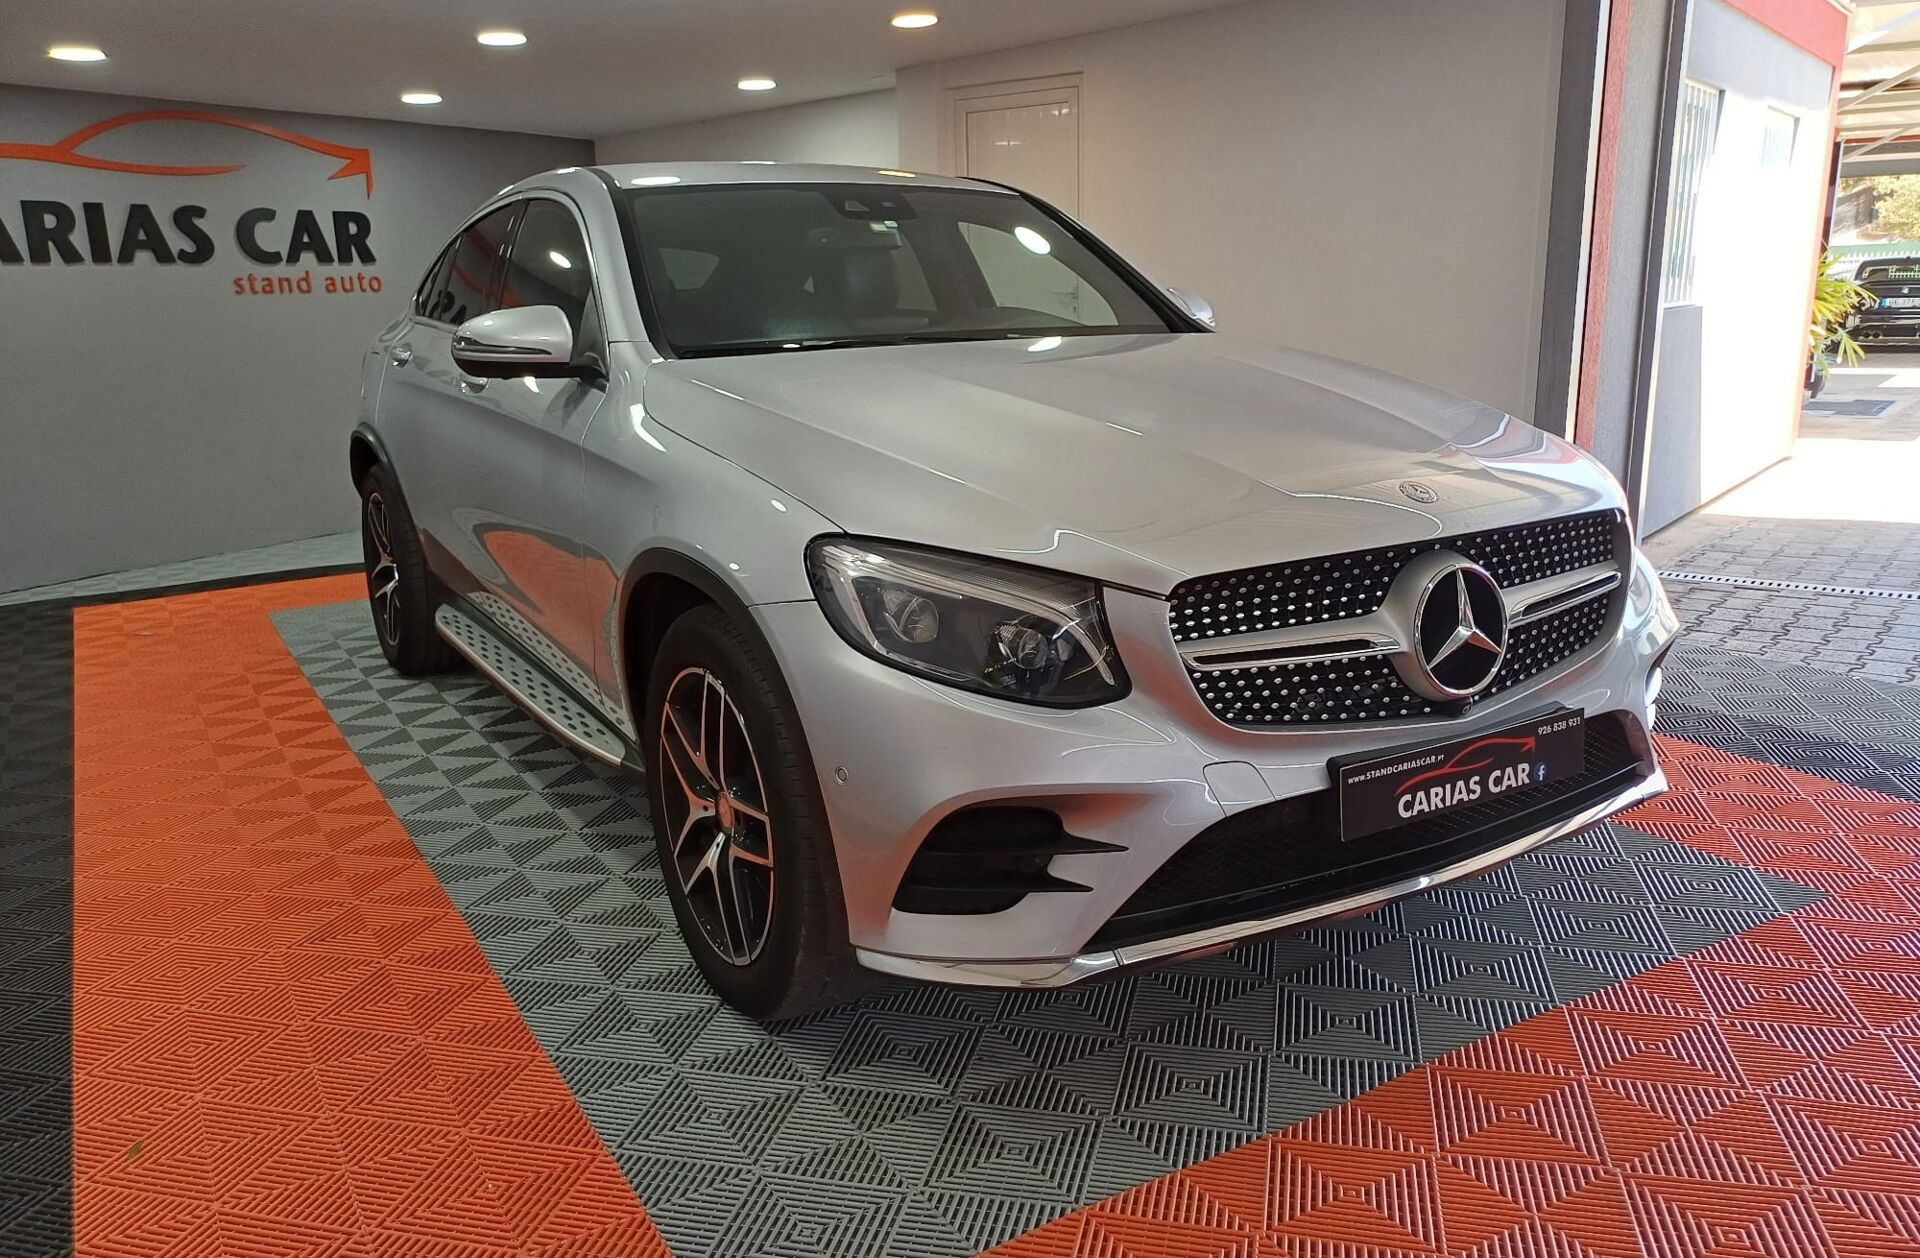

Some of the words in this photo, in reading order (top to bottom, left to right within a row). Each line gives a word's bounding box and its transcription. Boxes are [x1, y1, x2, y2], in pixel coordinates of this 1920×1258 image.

[235, 207, 377, 265] CAR
[233, 271, 312, 295] stand
[324, 274, 383, 294] auto
[1538, 725, 1551, 736] 926
[1553, 720, 1567, 731] 838
[1568, 716, 1581, 727] 931
[1397, 775, 1481, 819] CARIAS
[1488, 762, 1530, 794] CAR
